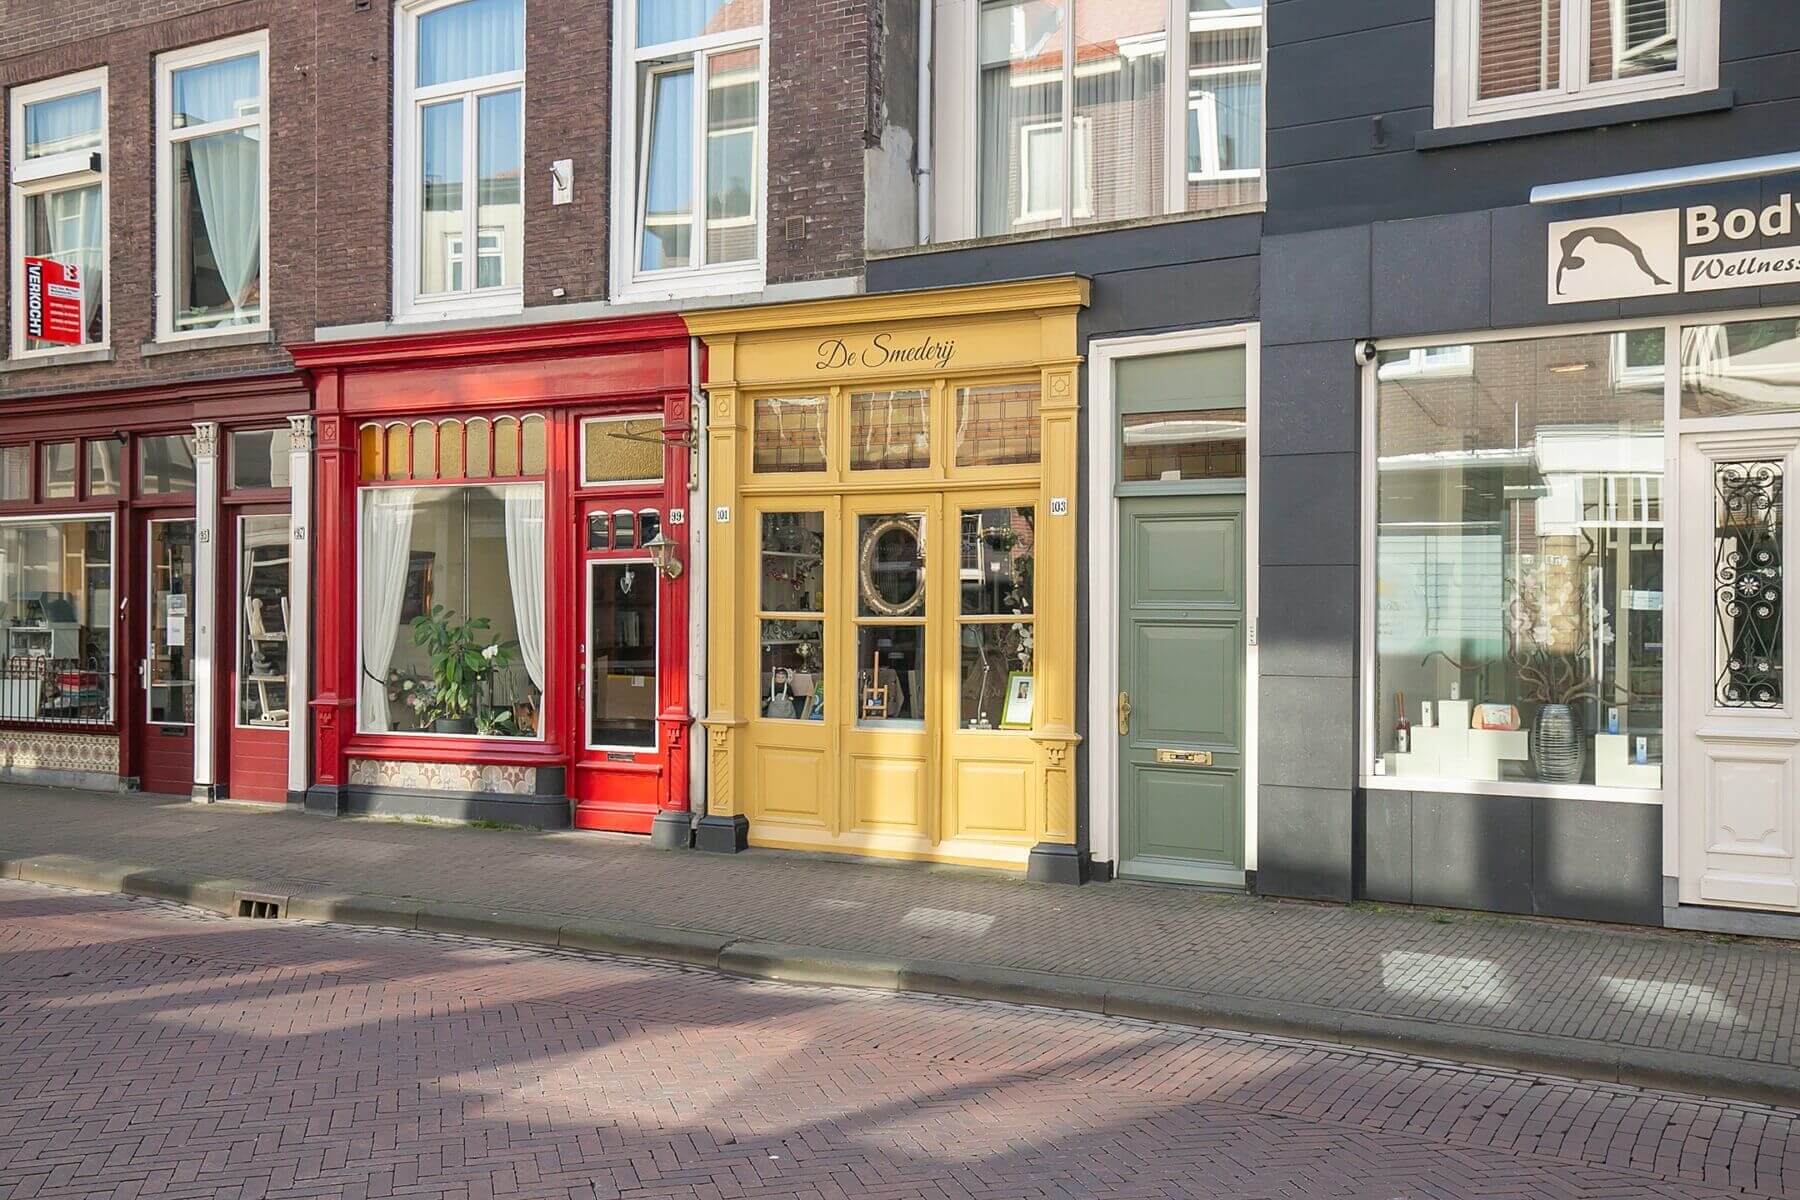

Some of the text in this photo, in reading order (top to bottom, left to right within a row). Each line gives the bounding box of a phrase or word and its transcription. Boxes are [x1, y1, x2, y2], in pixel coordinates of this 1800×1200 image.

[1686, 193, 1800, 245] Bod
[28, 266, 42, 336] VERKOCHT
[816, 333, 956, 369] De Smederij
[671, 511, 682, 521] 99
[717, 510, 728, 520] 101
[1051, 501, 1066, 513] 103
